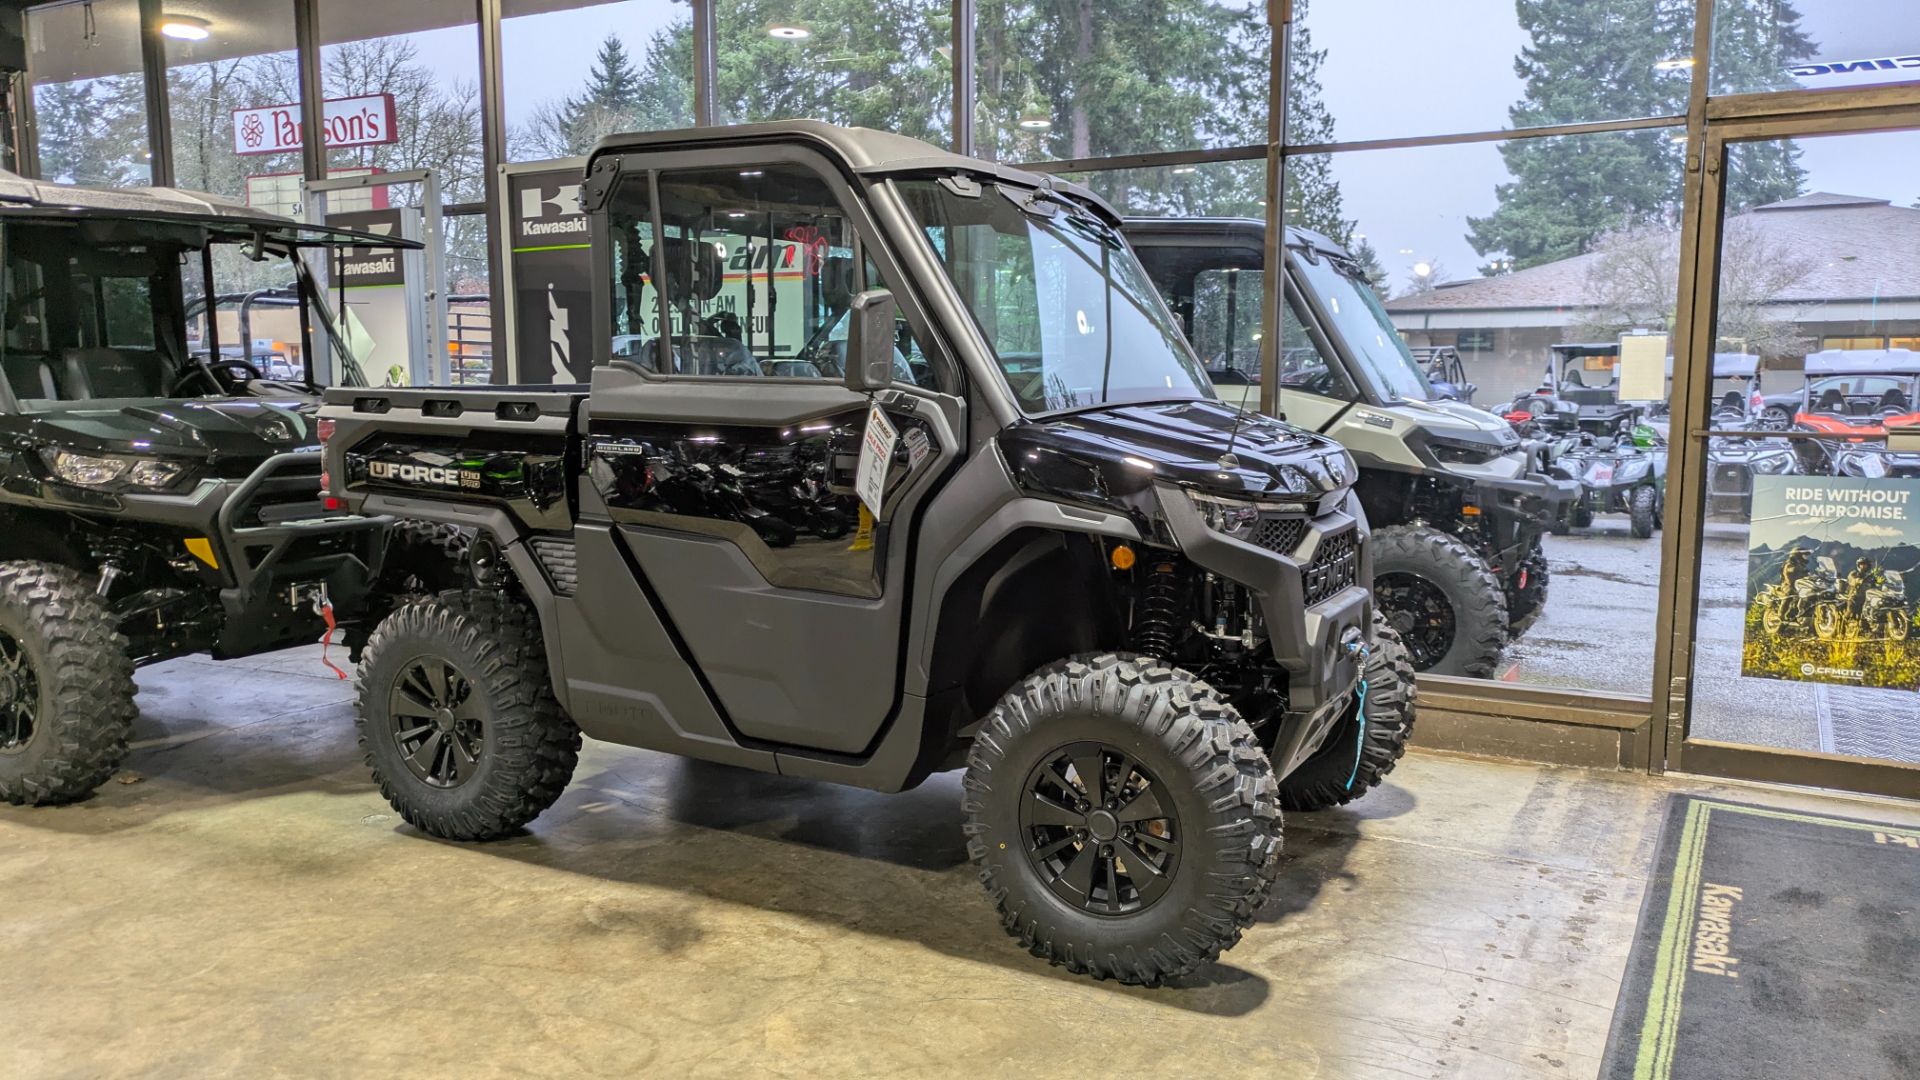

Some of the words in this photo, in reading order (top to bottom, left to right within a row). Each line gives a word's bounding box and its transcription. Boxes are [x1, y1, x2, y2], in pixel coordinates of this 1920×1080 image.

[522, 216, 587, 235] Kawasaki
[461, 480, 480, 489] PRO
[1785, 487, 1823, 501] RIDE
[1826, 488, 1911, 504] WITHOUT
[1785, 503, 1907, 520] COMPROMISE.
[1816, 667, 1864, 677] CFMOTO
[1692, 882, 1743, 978] Kawasaki
